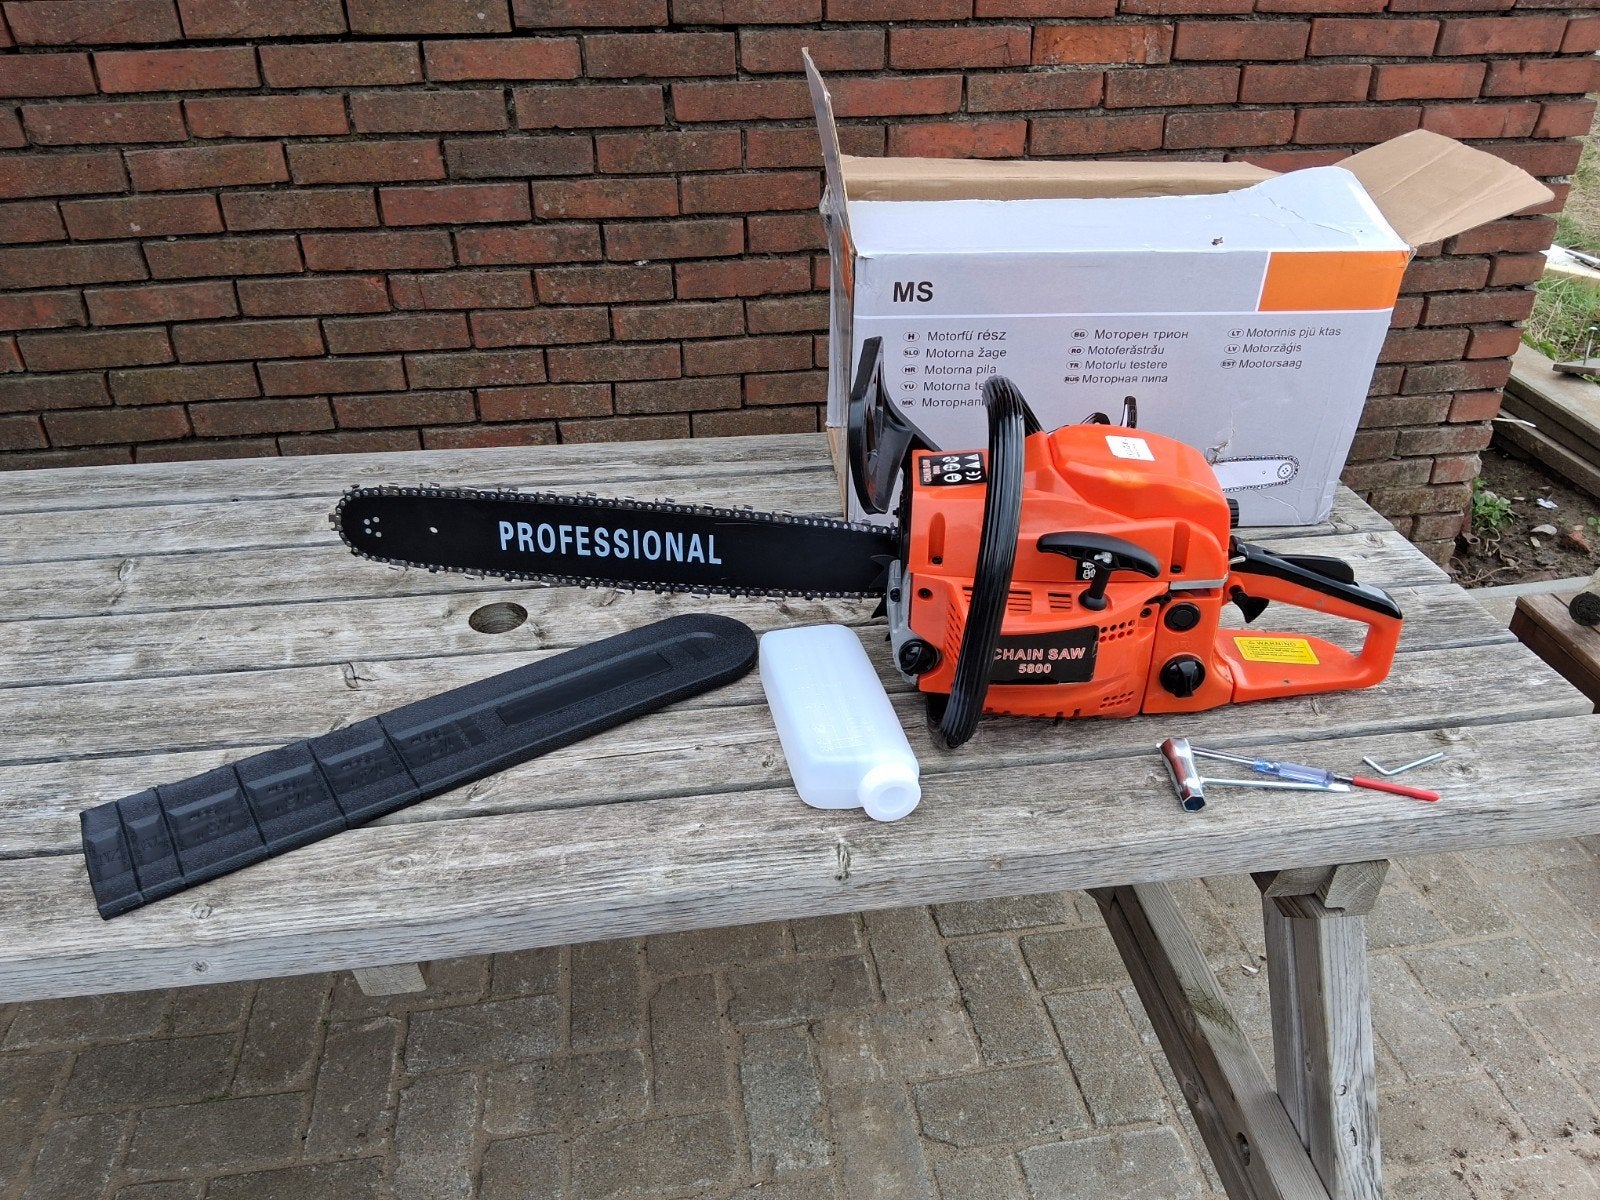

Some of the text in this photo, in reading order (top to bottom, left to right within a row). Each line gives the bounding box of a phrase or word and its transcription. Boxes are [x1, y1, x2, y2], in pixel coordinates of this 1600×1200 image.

[893, 281, 933, 302] MS
[977, 328, 1007, 341] rész
[1094, 329, 1149, 341] Моторен
[1153, 330, 1189, 341] трион
[1246, 327, 1296, 338] Motorinis
[1318, 326, 1342, 337] ktas
[926, 348, 974, 358] Motorna
[978, 347, 1007, 360] žage
[924, 365, 973, 375] Motorna
[976, 364, 997, 376] pila
[1085, 360, 1127, 370] Motorlu
[1129, 361, 1168, 370] testere
[1238, 359, 1303, 370] Mootorsaag
[923, 381, 971, 391] Motorna
[974, 381, 985, 391] te
[498, 520, 723, 565] PROFESSIONAL
[993, 646, 1087, 661] CHAIN SAW
[1018, 662, 1052, 674] 5800
